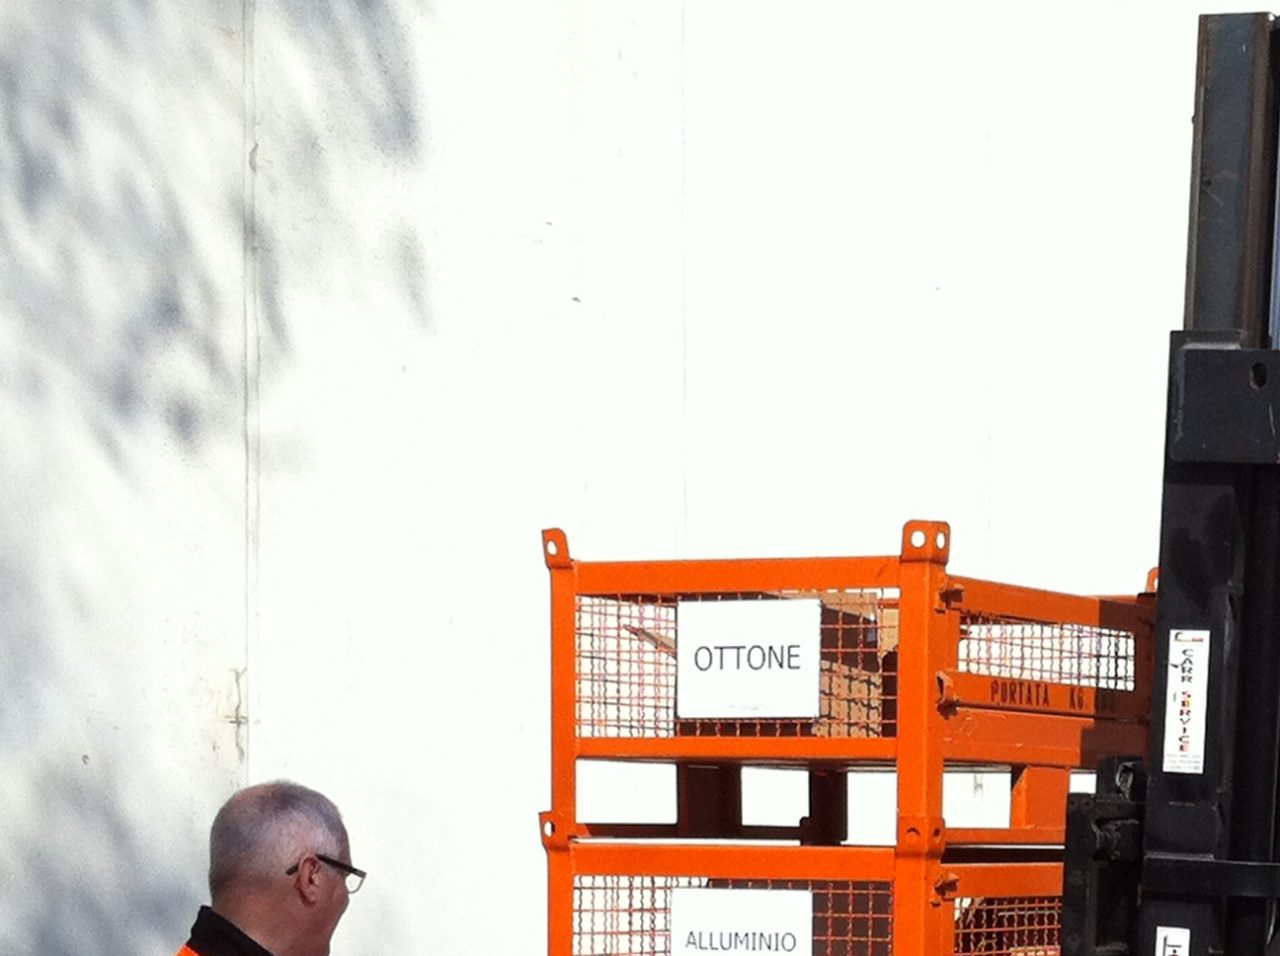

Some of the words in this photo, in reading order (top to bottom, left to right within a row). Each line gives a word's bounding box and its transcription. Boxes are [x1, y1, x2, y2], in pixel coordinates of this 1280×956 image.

[694, 644, 801, 671] OTTONE
[990, 679, 1050, 707] PORTATA
[685, 930, 797, 953] ALLUMINIO
